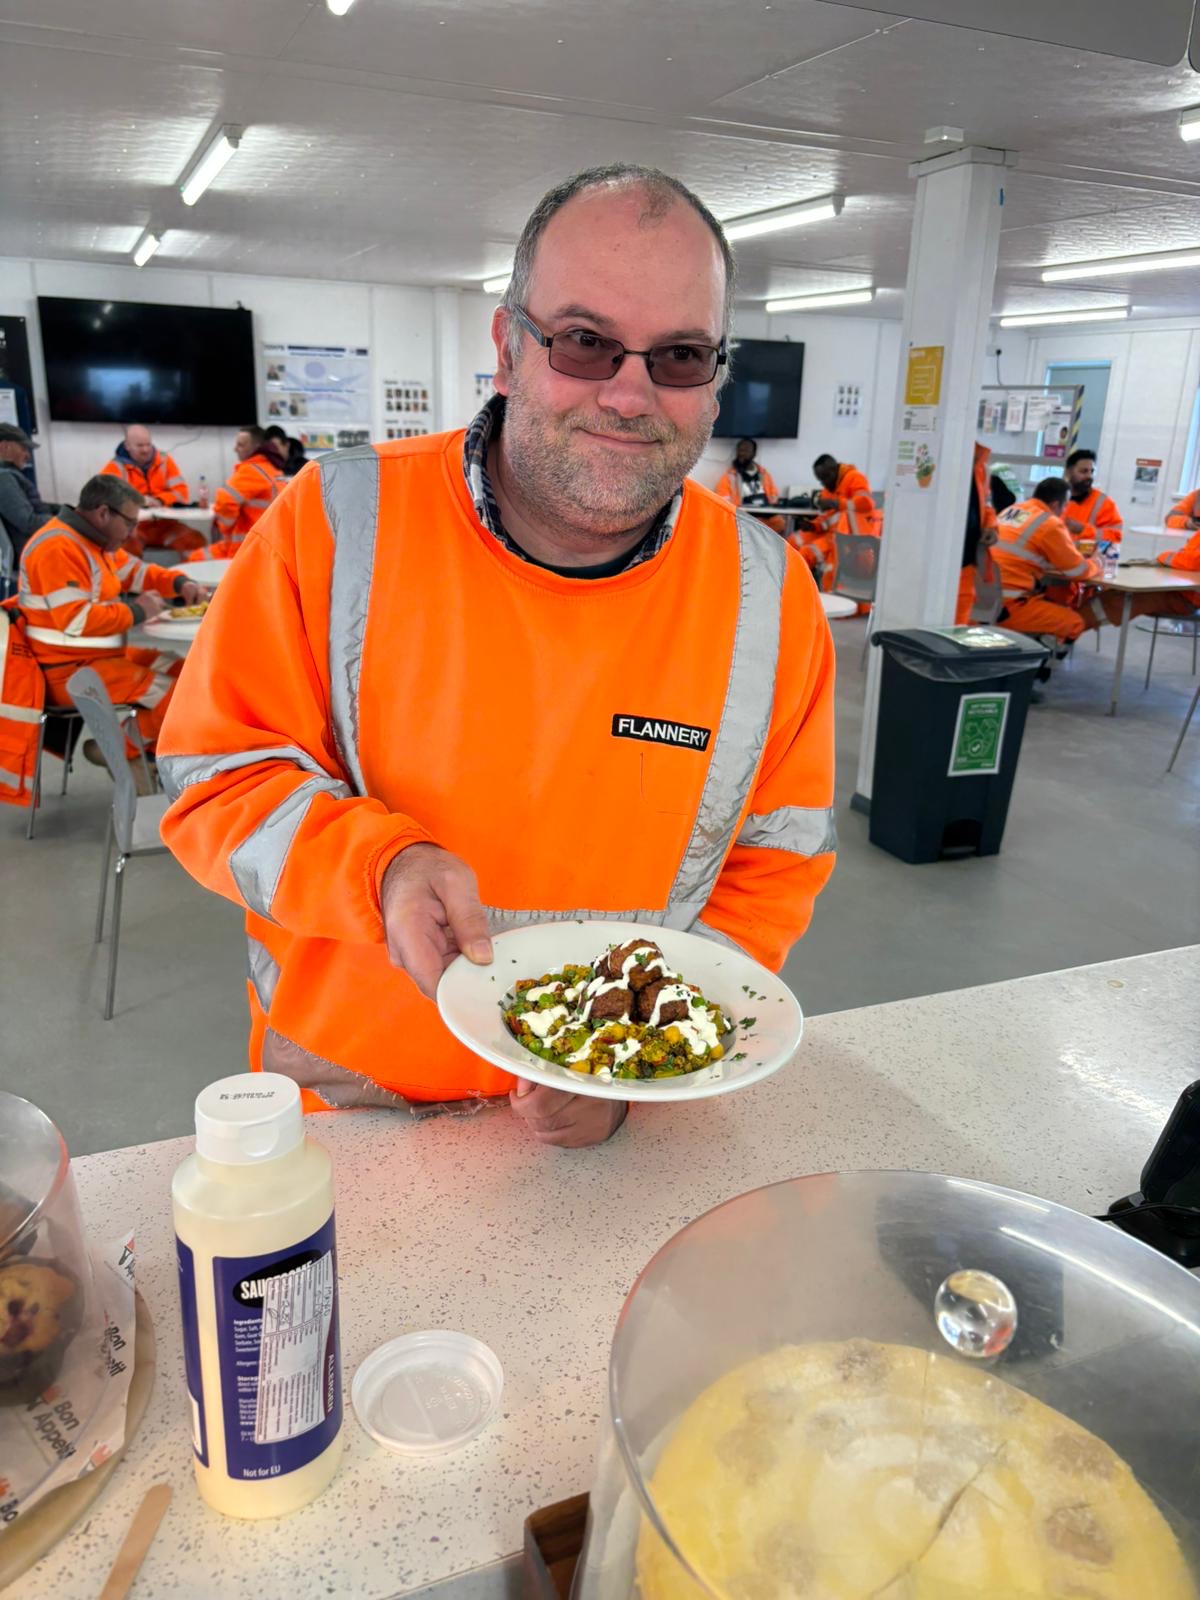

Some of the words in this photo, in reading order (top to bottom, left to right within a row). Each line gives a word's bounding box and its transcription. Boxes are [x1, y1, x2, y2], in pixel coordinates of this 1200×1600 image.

[618, 717, 709, 747] FLANNERY
[327, 1354, 335, 1413] ALLERGEN
[54, 1400, 80, 1431] Bon
[243, 1468, 256, 1477] Not
[258, 1467, 269, 1476] for
[270, 1464, 281, 1474] EU
